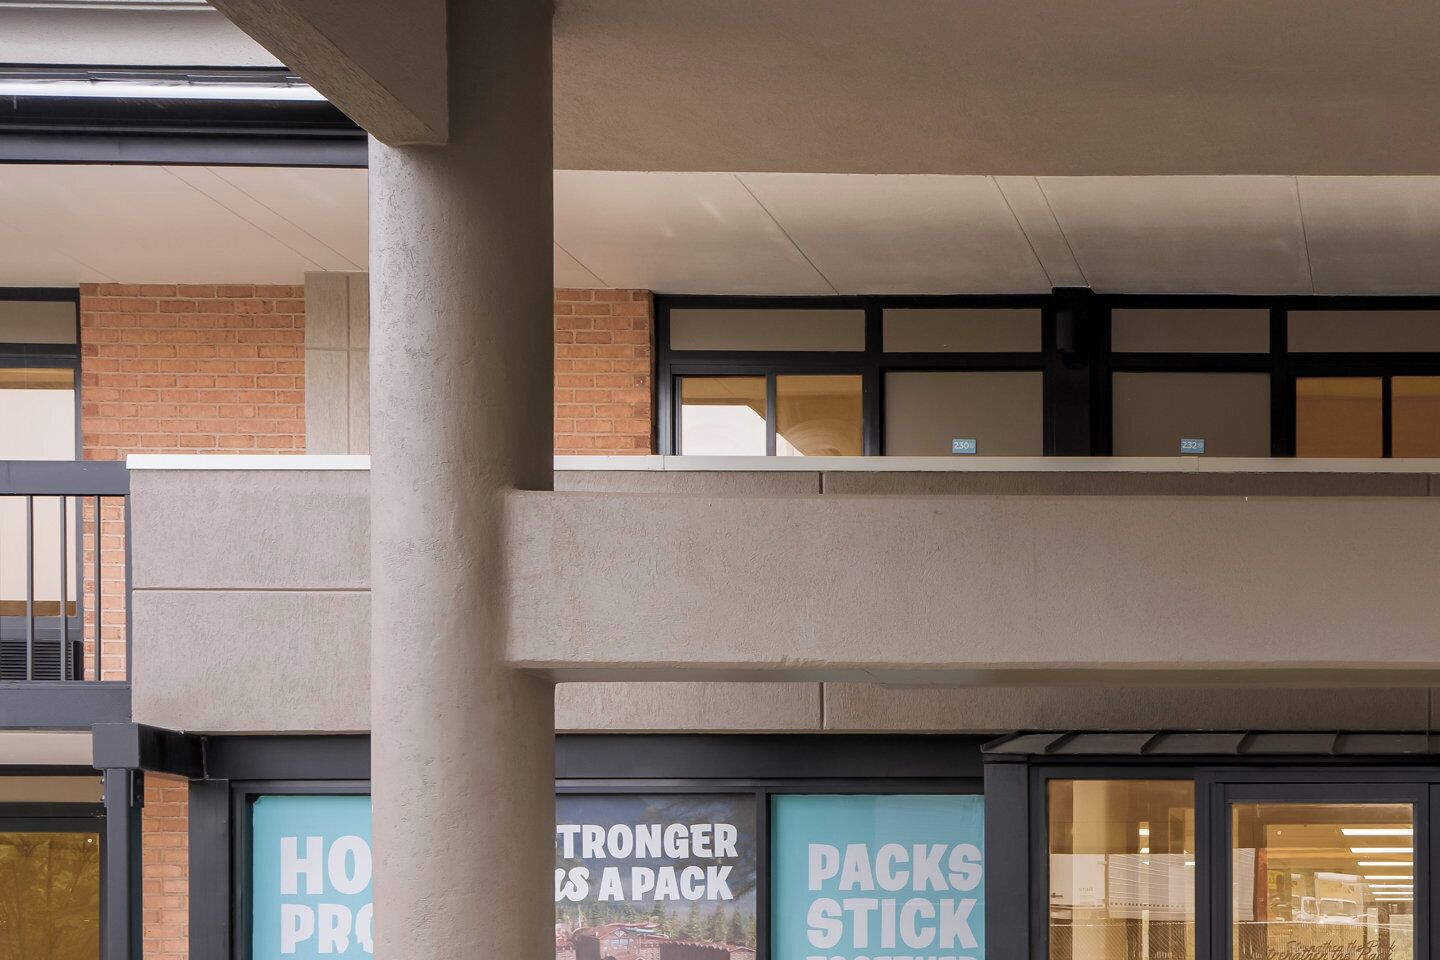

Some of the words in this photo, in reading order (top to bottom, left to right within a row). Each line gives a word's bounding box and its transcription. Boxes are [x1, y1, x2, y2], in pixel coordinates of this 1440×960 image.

[953, 441, 970, 450] 230
[1181, 441, 1197, 449] 232
[556, 823, 739, 859] TRONGER
[597, 866, 625, 901] A
[631, 865, 734, 901] PACK
[807, 843, 983, 892] PACKS
[806, 897, 979, 949] STICK
